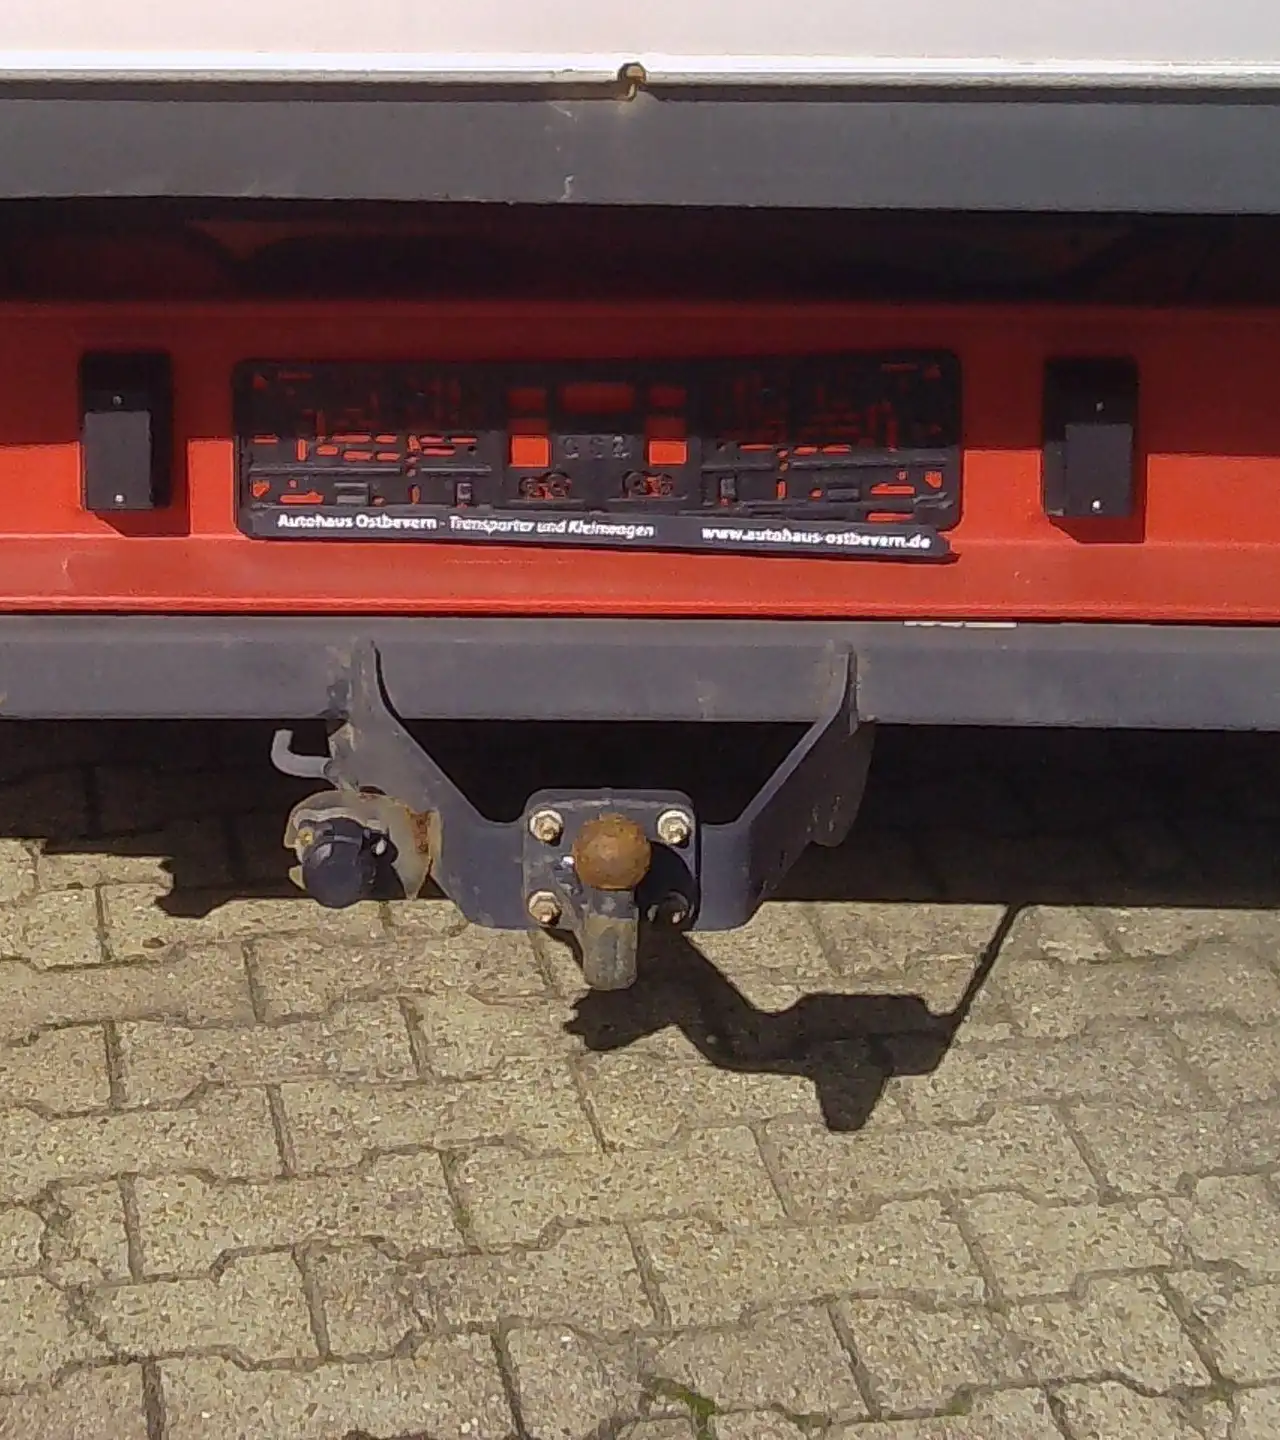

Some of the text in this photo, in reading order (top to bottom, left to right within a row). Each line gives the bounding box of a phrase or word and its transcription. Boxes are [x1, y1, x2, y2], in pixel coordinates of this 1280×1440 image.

[277, 513, 353, 528] Autohaus
[355, 512, 438, 530] Ostbevern
[449, 515, 535, 536] Transporter
[536, 519, 566, 534] und
[567, 520, 655, 540] Kleinwagen
[701, 527, 932, 549] www.autohaus-ostbevern.de
